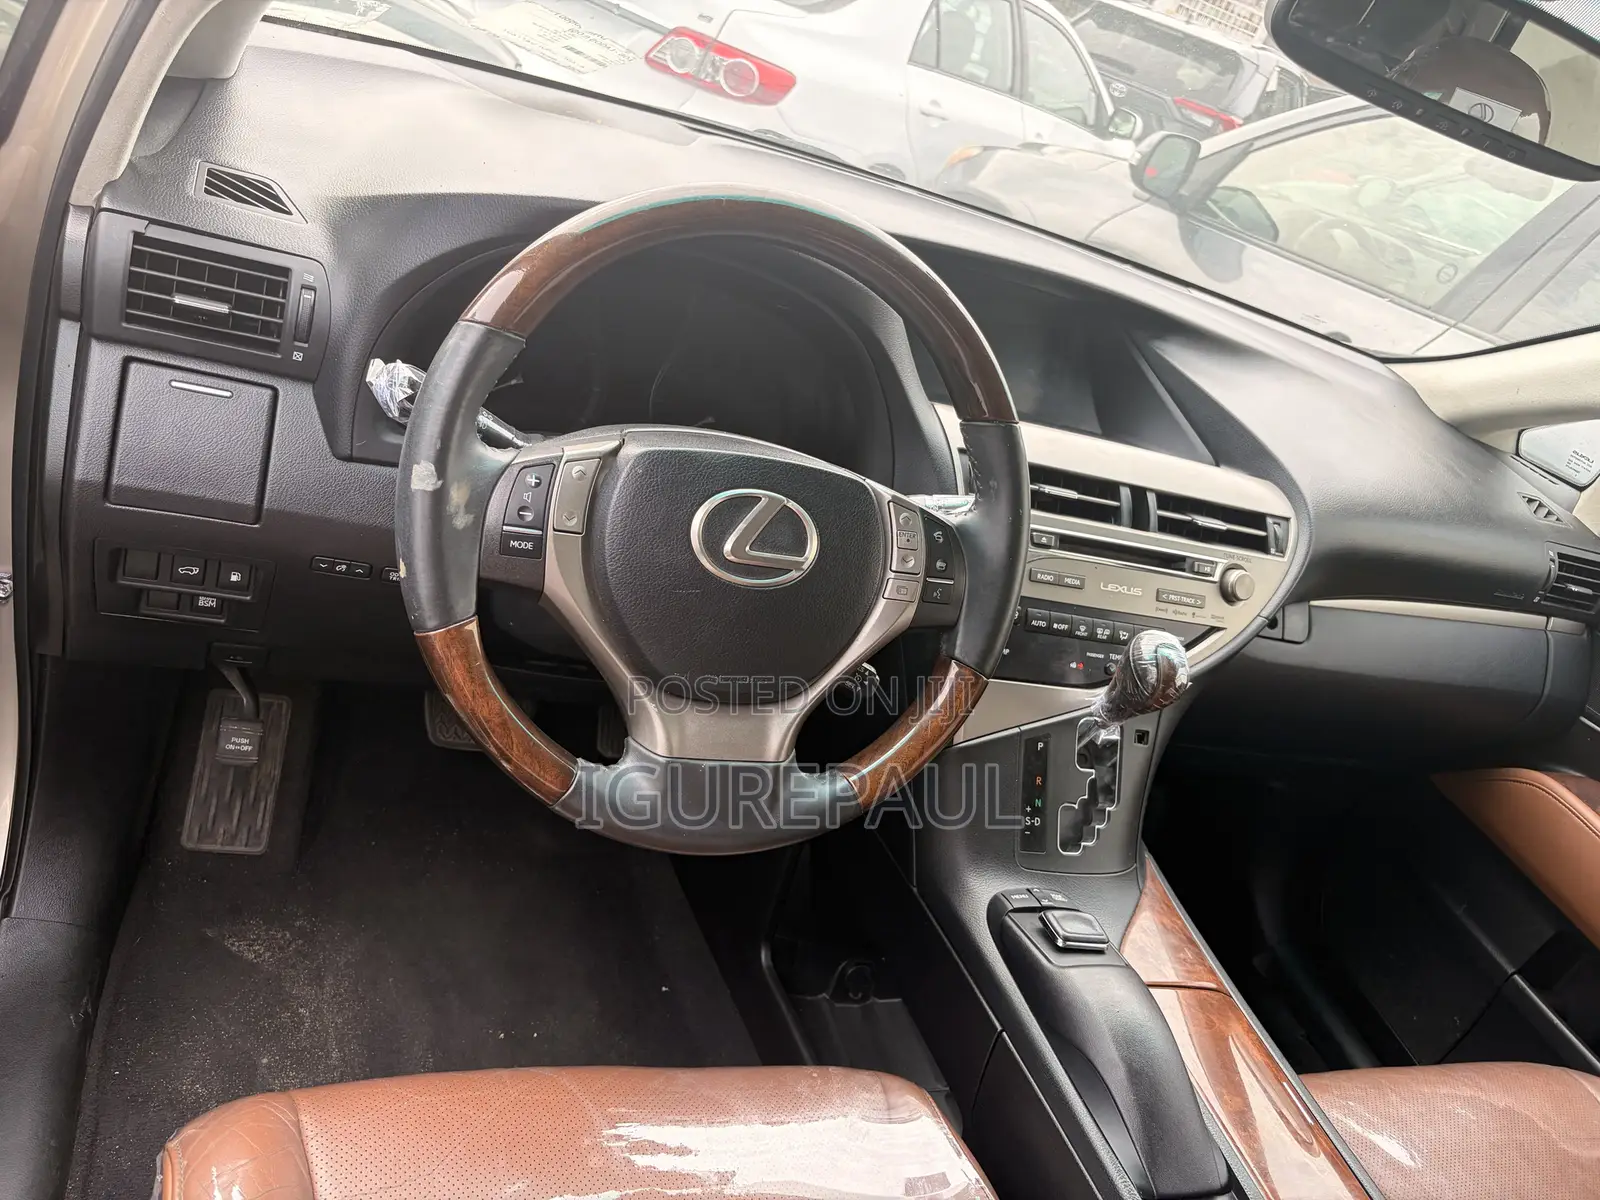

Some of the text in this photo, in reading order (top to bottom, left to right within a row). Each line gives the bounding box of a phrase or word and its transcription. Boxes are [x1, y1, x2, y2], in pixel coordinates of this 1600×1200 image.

[509, 540, 534, 550] MODE
[1037, 573, 1054, 582] RADIO
[1064, 577, 1081, 586] MEDIA
[1100, 582, 1143, 596] LEXUS
[198, 599, 216, 608] BSM
[1031, 620, 1047, 628] AUTO
[1058, 623, 1069, 631] OFF
[1037, 742, 1044, 751] P
[1036, 776, 1042, 785] R
[1035, 799, 1042, 807] N
